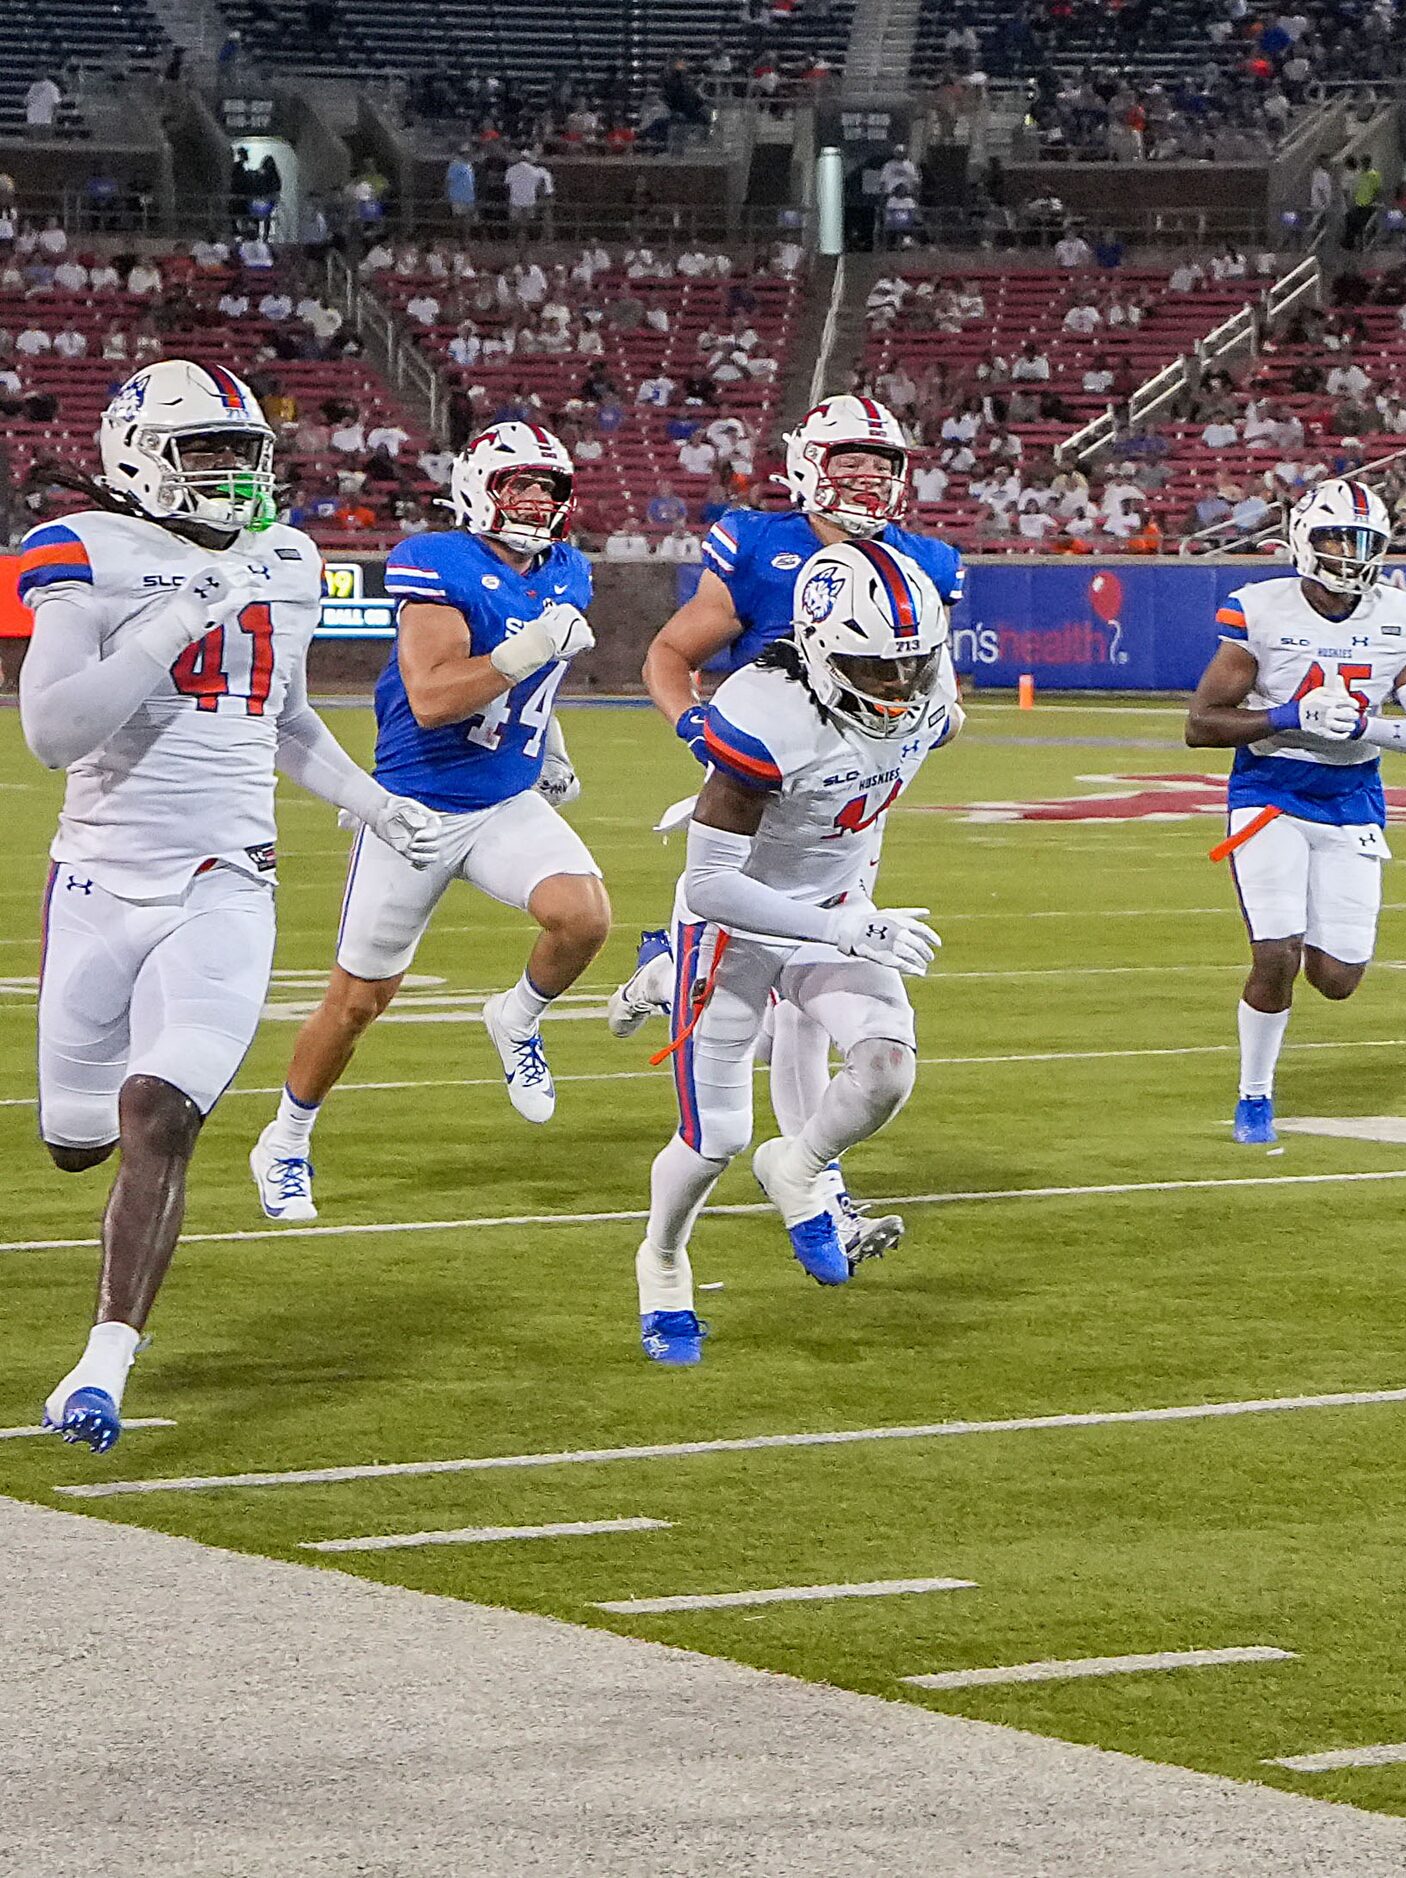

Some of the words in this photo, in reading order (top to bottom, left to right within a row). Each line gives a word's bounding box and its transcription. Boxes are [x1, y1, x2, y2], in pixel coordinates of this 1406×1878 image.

[895, 639, 920, 652] 713
[1318, 648, 1352, 658] HUSKIES
[170, 601, 274, 717] 41
[859, 767, 901, 791] HUSKIES
